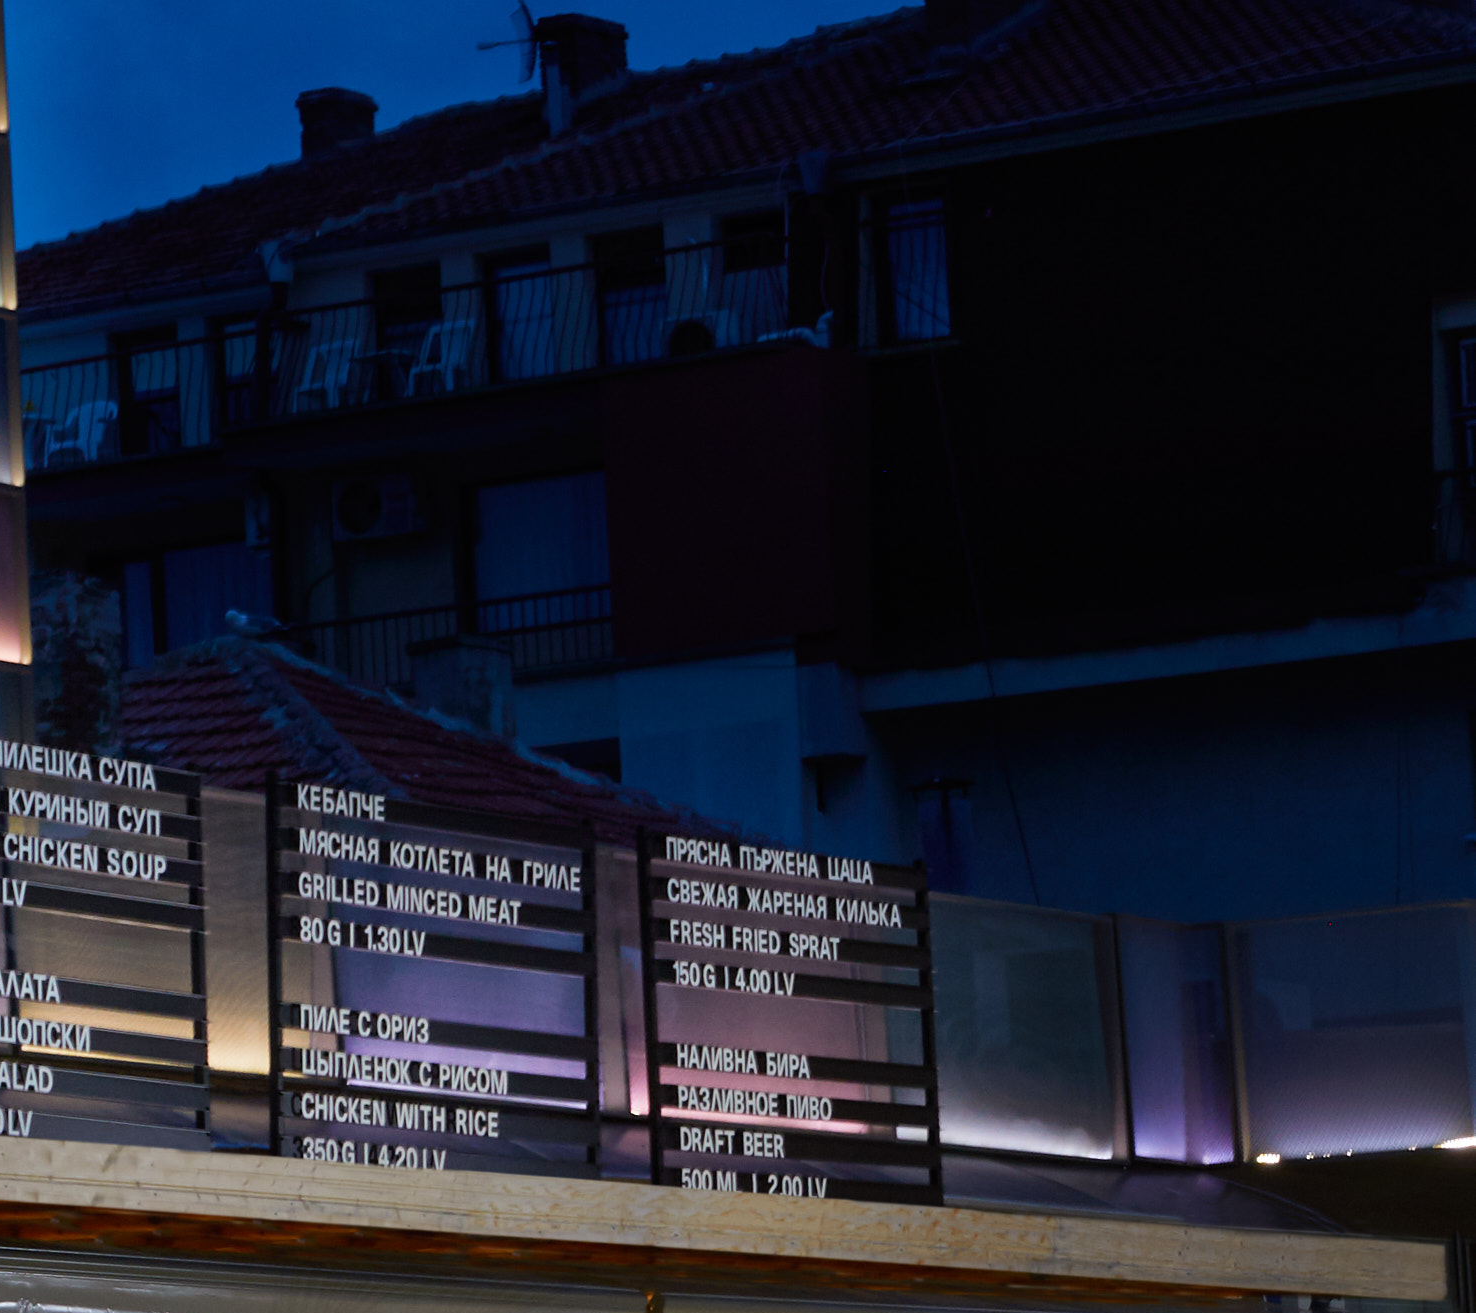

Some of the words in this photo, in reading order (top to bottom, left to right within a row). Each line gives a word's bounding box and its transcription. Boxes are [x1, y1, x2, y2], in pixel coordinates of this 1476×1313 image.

[99, 757, 156, 791] СУПА
[8, 787, 108, 830] КУРИНЫЙ
[117, 807, 160, 837] СУП
[297, 783, 385, 822] КЕБАПЧЕ
[3, 834, 99, 873] CHICKEN
[107, 852, 167, 881] SOUP
[299, 828, 379, 864] МЯСНАЯ
[389, 841, 475, 878] КОТЛЕТА
[485, 855, 511, 882] НА
[522, 859, 581, 893] ГРИЛЕ
[666, 837, 731, 868] ПРЯСНА
[739, 846, 819, 879] ПЪРЖЕНА
[828, 857, 874, 886] ЦАЦА
[298, 873, 380, 907] GRILLED
[386, 885, 461, 918] MINCED
[468, 896, 521, 925] MEAT
[667, 879, 738, 908] СВЕЖАЯ
[747, 887, 827, 920] ЖАРЕНАЯ
[836, 901, 902, 928] КИЛЬКА
[300, 917, 324, 942] 80
[670, 920, 724, 950] FRESH
[733, 926, 780, 954] FRIED
[789, 934, 840, 961] SPRAT
[673, 961, 700, 986] 150
[300, 1005, 350, 1035] ПИЛЕ
[357, 1011, 371, 1035] С
[377, 1013, 429, 1044] ОРИЗ
[301, 1050, 411, 1086] ЦЫПЛЕНОК
[419, 1061, 432, 1086] С
[439, 1064, 507, 1095] РИСОМ
[676, 1044, 757, 1075] НАЛИВНА
[766, 1051, 810, 1080] БИРА
[301, 1094, 386, 1128] CHICKEN
[395, 1102, 446, 1132] WITH
[455, 1109, 500, 1137] RICE
[678, 1086, 779, 1117] РАЗЛИВНОЕ
[786, 1094, 832, 1121] ПИВО
[303, 1137, 338, 1161] 350
[680, 1127, 735, 1154] DRAFT
[742, 1132, 785, 1159] BEER
[682, 1169, 711, 1191] 500
